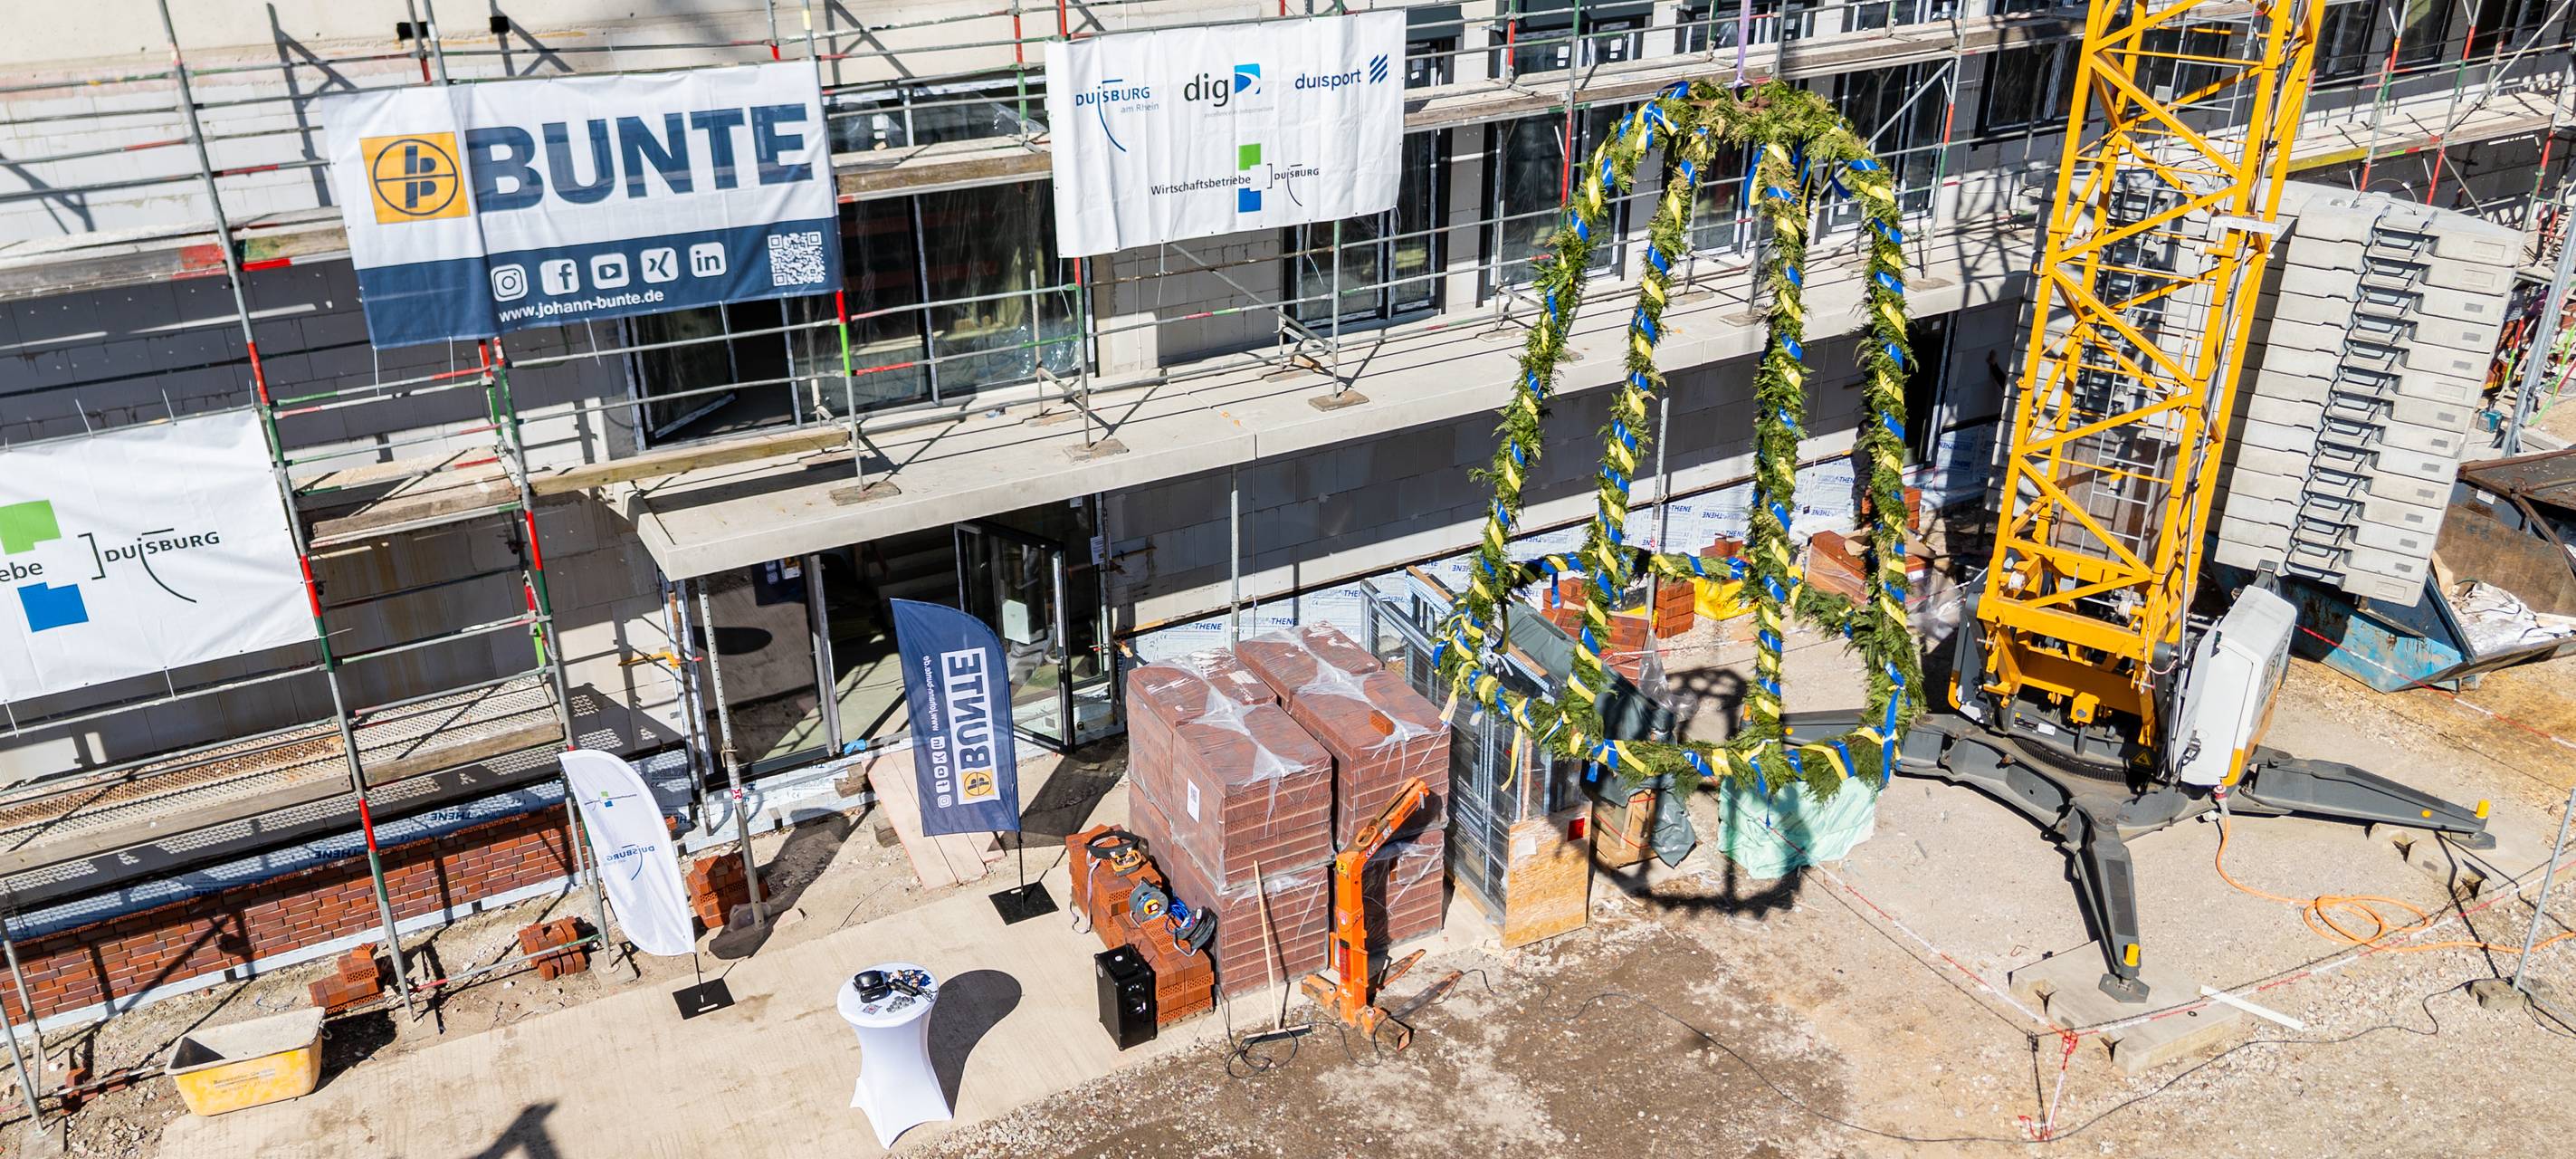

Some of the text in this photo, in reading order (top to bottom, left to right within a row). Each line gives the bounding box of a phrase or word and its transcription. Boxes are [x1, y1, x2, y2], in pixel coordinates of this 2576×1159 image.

[1184, 73, 1230, 107] dig
[1295, 68, 1362, 91] duisport
[1136, 101, 1159, 113] Rhein
[464, 102, 814, 214] BUNTE
[1150, 174, 1251, 196] Wirtschaftsbetriebe
[499, 288, 664, 323] www.johann-bunte.de
[1195, 622, 1223, 630] THENE
